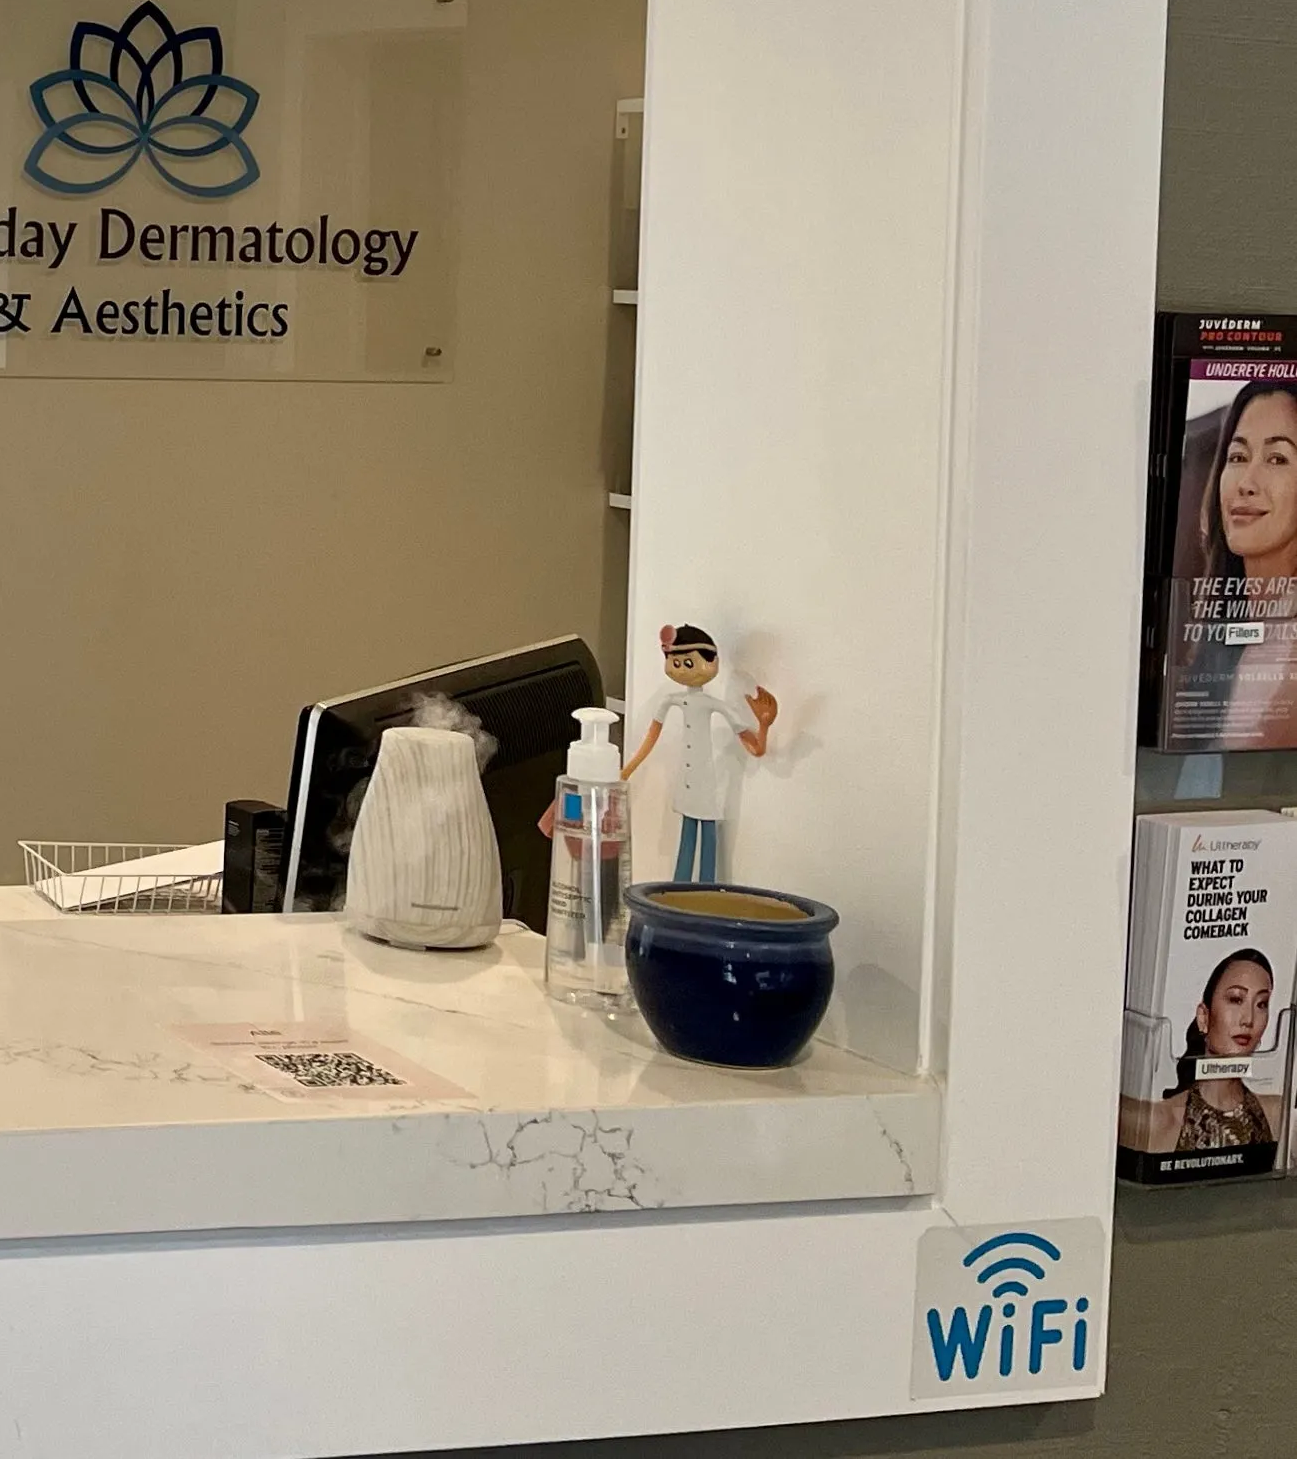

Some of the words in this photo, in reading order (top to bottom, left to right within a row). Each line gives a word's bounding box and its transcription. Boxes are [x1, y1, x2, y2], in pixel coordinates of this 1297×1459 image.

[99, 208, 419, 275] Dermatology
[51, 287, 288, 337] Aesthetics
[1200, 331, 1224, 341] PRO
[1227, 332, 1282, 341] CONTOUR
[1206, 363, 1267, 377] UNDEREYE
[1268, 363, 1297, 378] HOLL
[1192, 577, 1223, 596] THE
[1224, 577, 1261, 596] EYES
[1264, 576, 1297, 595] ARE
[1193, 600, 1224, 619] THE
[1226, 598, 1293, 619] WINDOW
[1183, 623, 1203, 642] TO
[1228, 626, 1260, 639] Fillers
[1210, 839, 1262, 852] Ultherapy
[1191, 860, 1226, 875] WHAT
[1229, 859, 1244, 873] TO
[1189, 876, 1235, 891] EXPECT
[1187, 892, 1233, 907] DURING
[1237, 889, 1268, 904] YOUR
[1186, 906, 1247, 923] COLLAGEN
[1184, 922, 1249, 940] COMEBACK
[1201, 1061, 1251, 1076] Ultherapy
[927, 1297, 1089, 1382] WiFi
